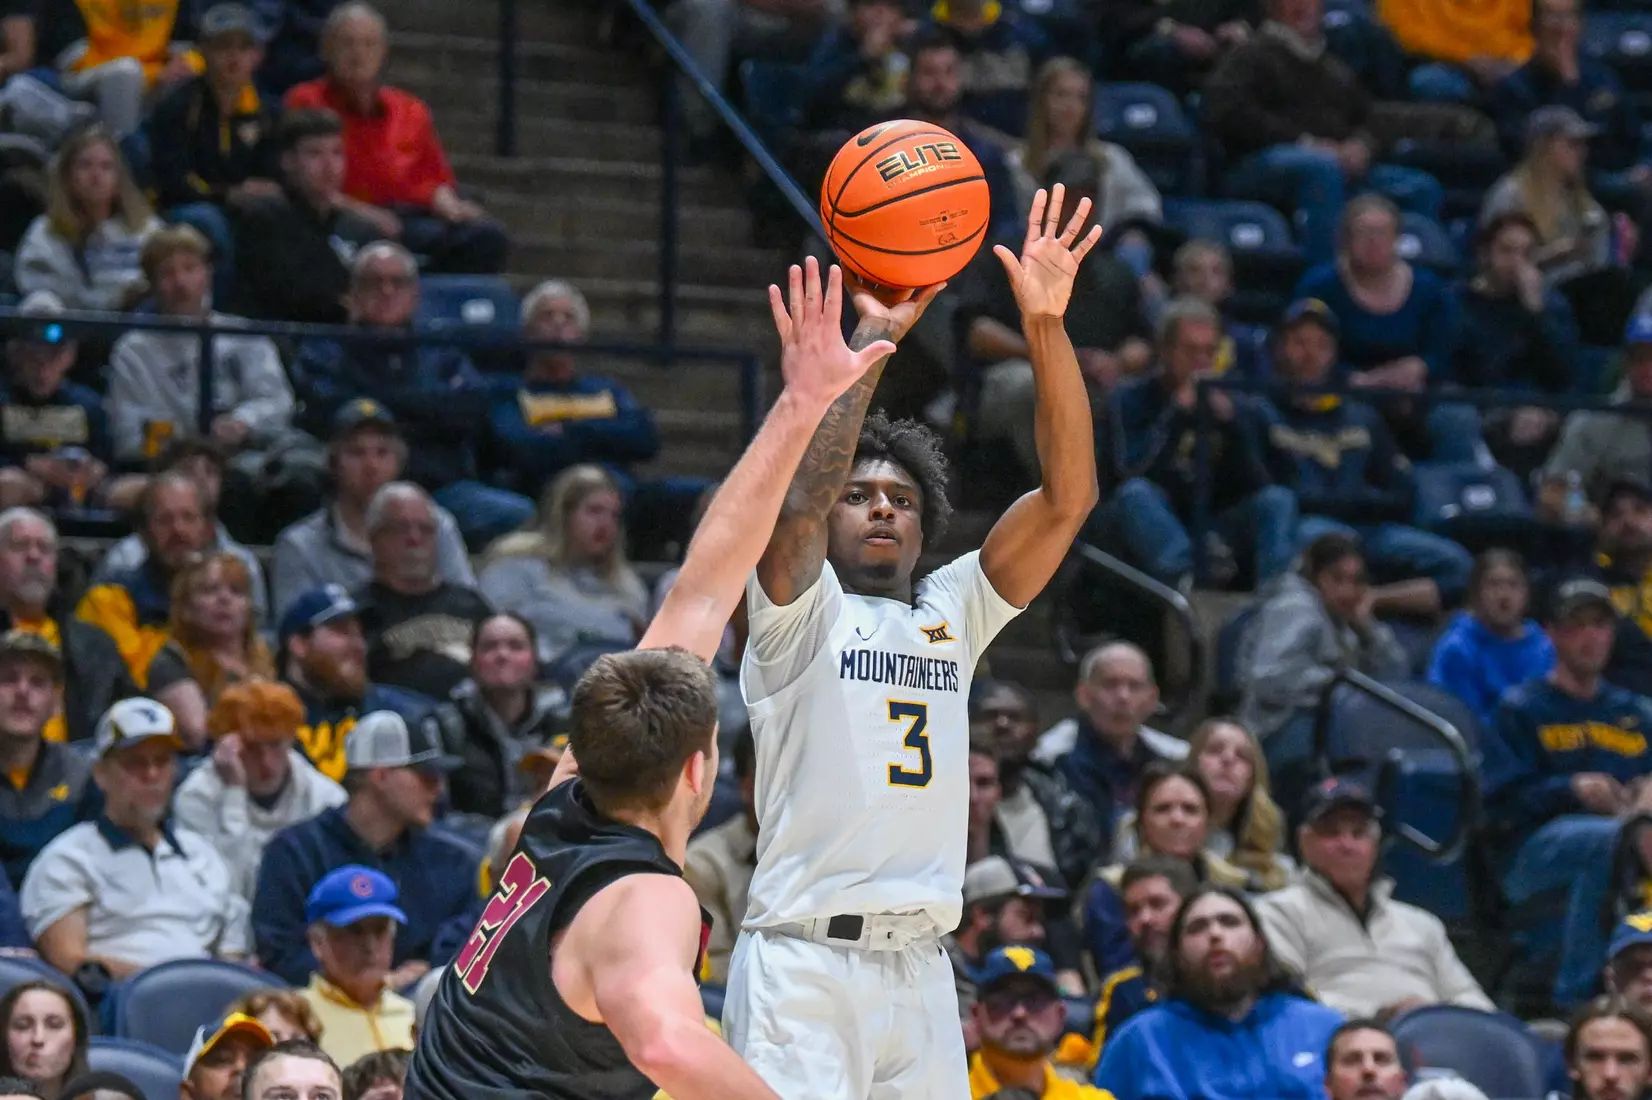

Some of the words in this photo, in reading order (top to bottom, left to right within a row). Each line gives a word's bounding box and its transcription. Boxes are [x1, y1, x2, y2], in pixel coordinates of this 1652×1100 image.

[875, 142, 962, 182] ELITE
[839, 649, 959, 693] MOUNTAINEERS
[886, 698, 932, 789] 3
[453, 851, 551, 995] 21
